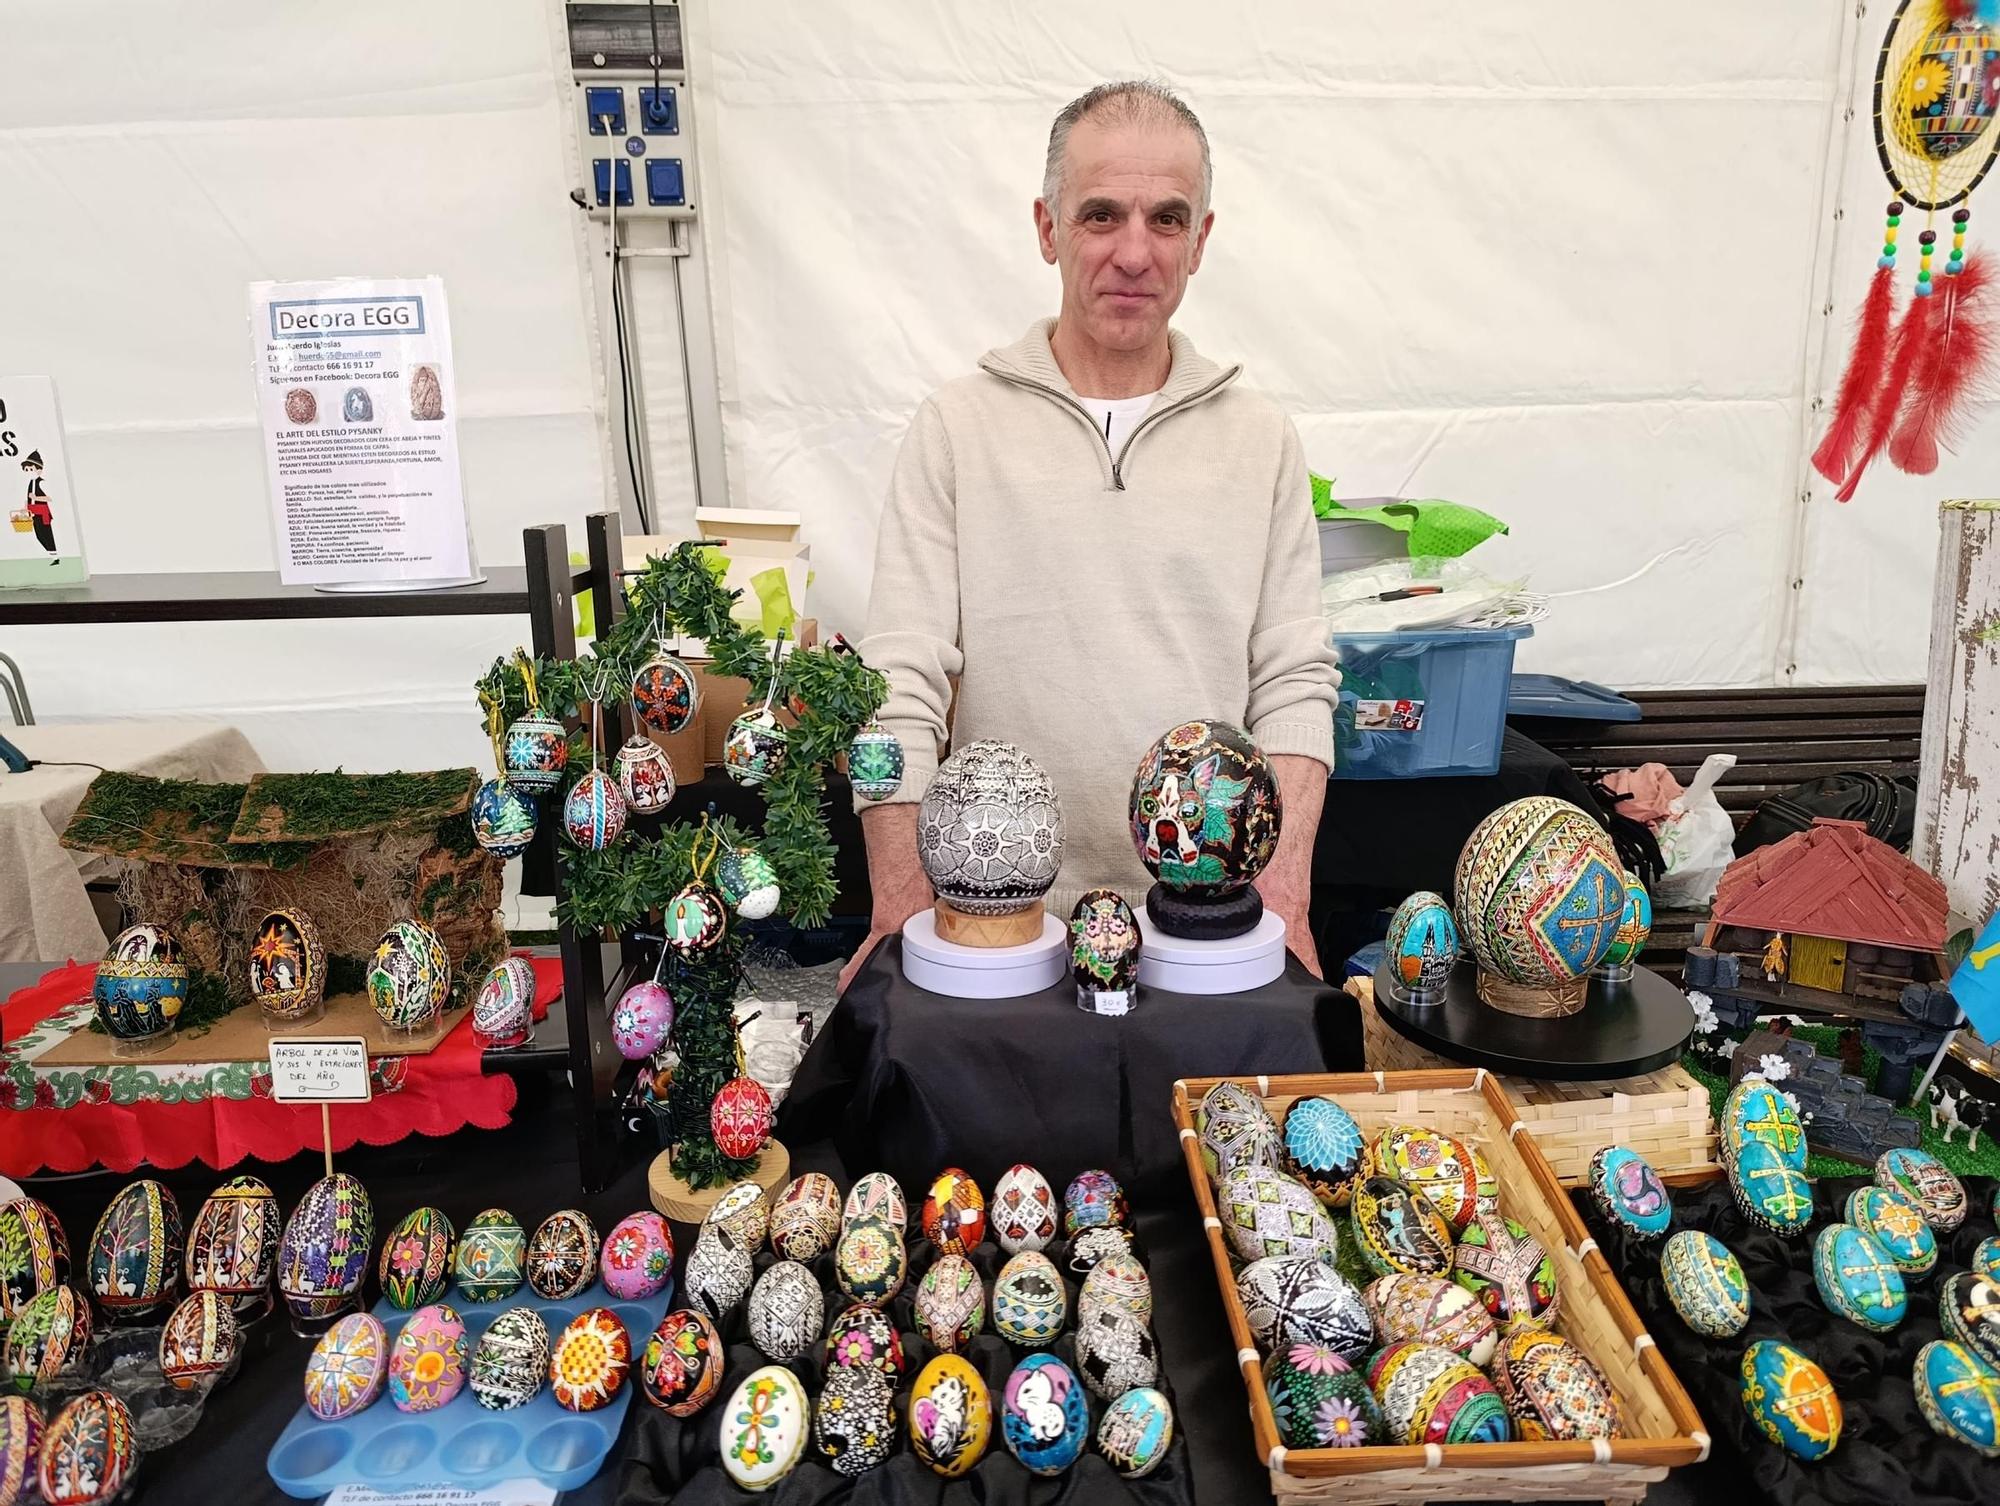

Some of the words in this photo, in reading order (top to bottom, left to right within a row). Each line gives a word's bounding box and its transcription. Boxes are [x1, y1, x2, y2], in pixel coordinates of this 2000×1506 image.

[280, 311, 356, 330] Decora
[363, 306, 410, 326] EGG
[294, 363, 325, 371] contacto
[327, 362, 341, 370] 666
[353, 361, 363, 369] 91
[304, 374, 313, 382] en
[315, 373, 353, 382] Facebook:
[355, 372, 381, 380] Decora
[383, 371, 399, 379] EGG
[276, 431, 284, 439] EL
[322, 429, 347, 437] ESTILO
[348, 427, 383, 435] PYSANKY
[276, 1048, 306, 1058] ARBOL
[316, 1071, 335, 1080] AÑO
